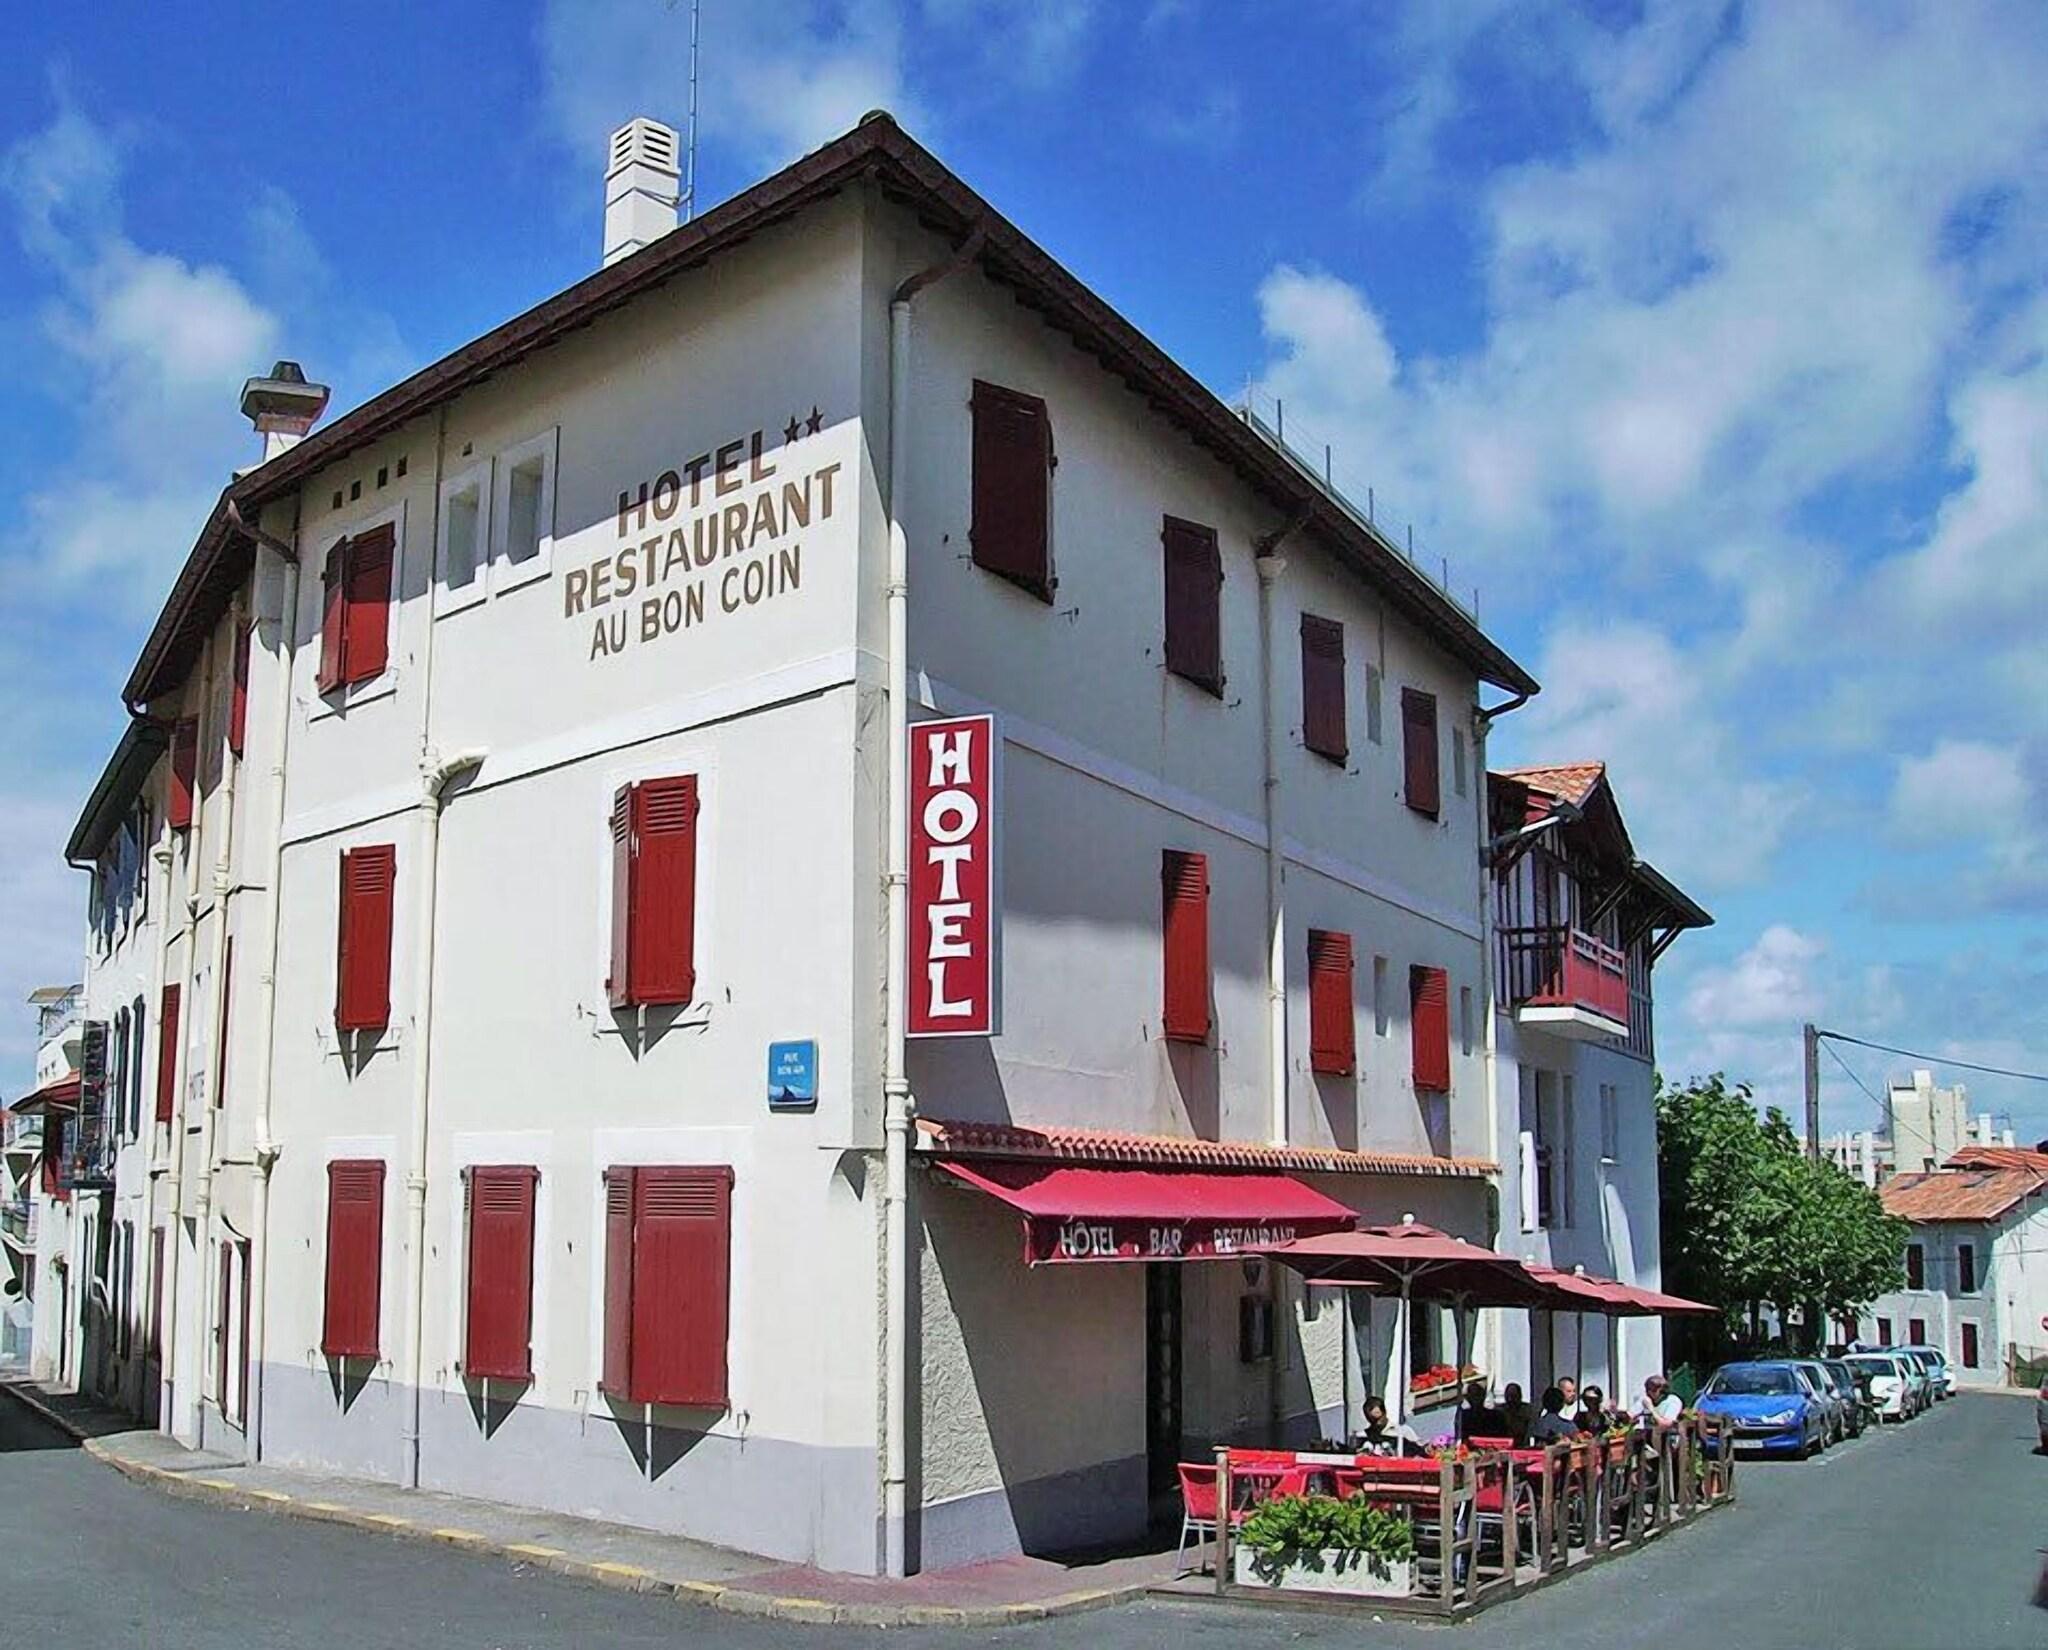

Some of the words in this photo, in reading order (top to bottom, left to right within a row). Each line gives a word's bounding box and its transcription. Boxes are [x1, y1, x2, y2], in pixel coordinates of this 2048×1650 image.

[564, 462, 841, 618] RESTAURANT
[617, 430, 777, 538] HOTEL
[590, 609, 628, 661] AU
[640, 580, 704, 642] BON
[721, 544, 801, 613] COIN
[923, 729, 979, 1018] HOTEL
[1060, 1222, 1117, 1255] HÔTEL
[1150, 1228, 1182, 1255] BAR
